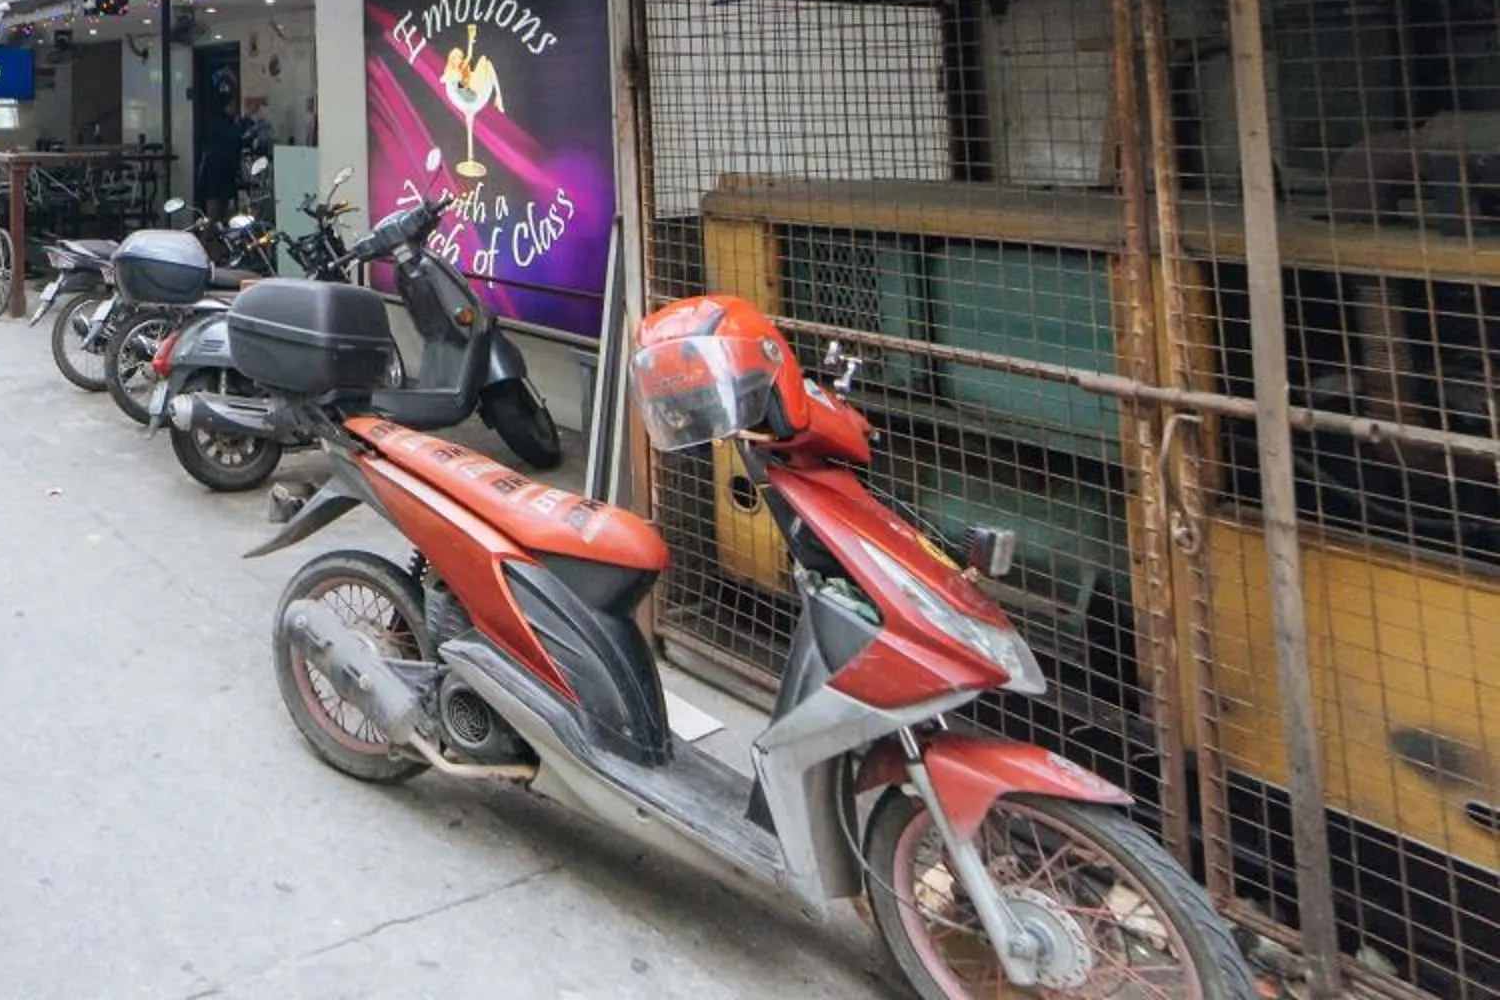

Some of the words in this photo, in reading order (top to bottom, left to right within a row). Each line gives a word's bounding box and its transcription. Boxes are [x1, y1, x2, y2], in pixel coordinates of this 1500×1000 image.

[473, 227, 503, 290] of
[512, 187, 575, 268] Class
[495, 195, 509, 220] a
